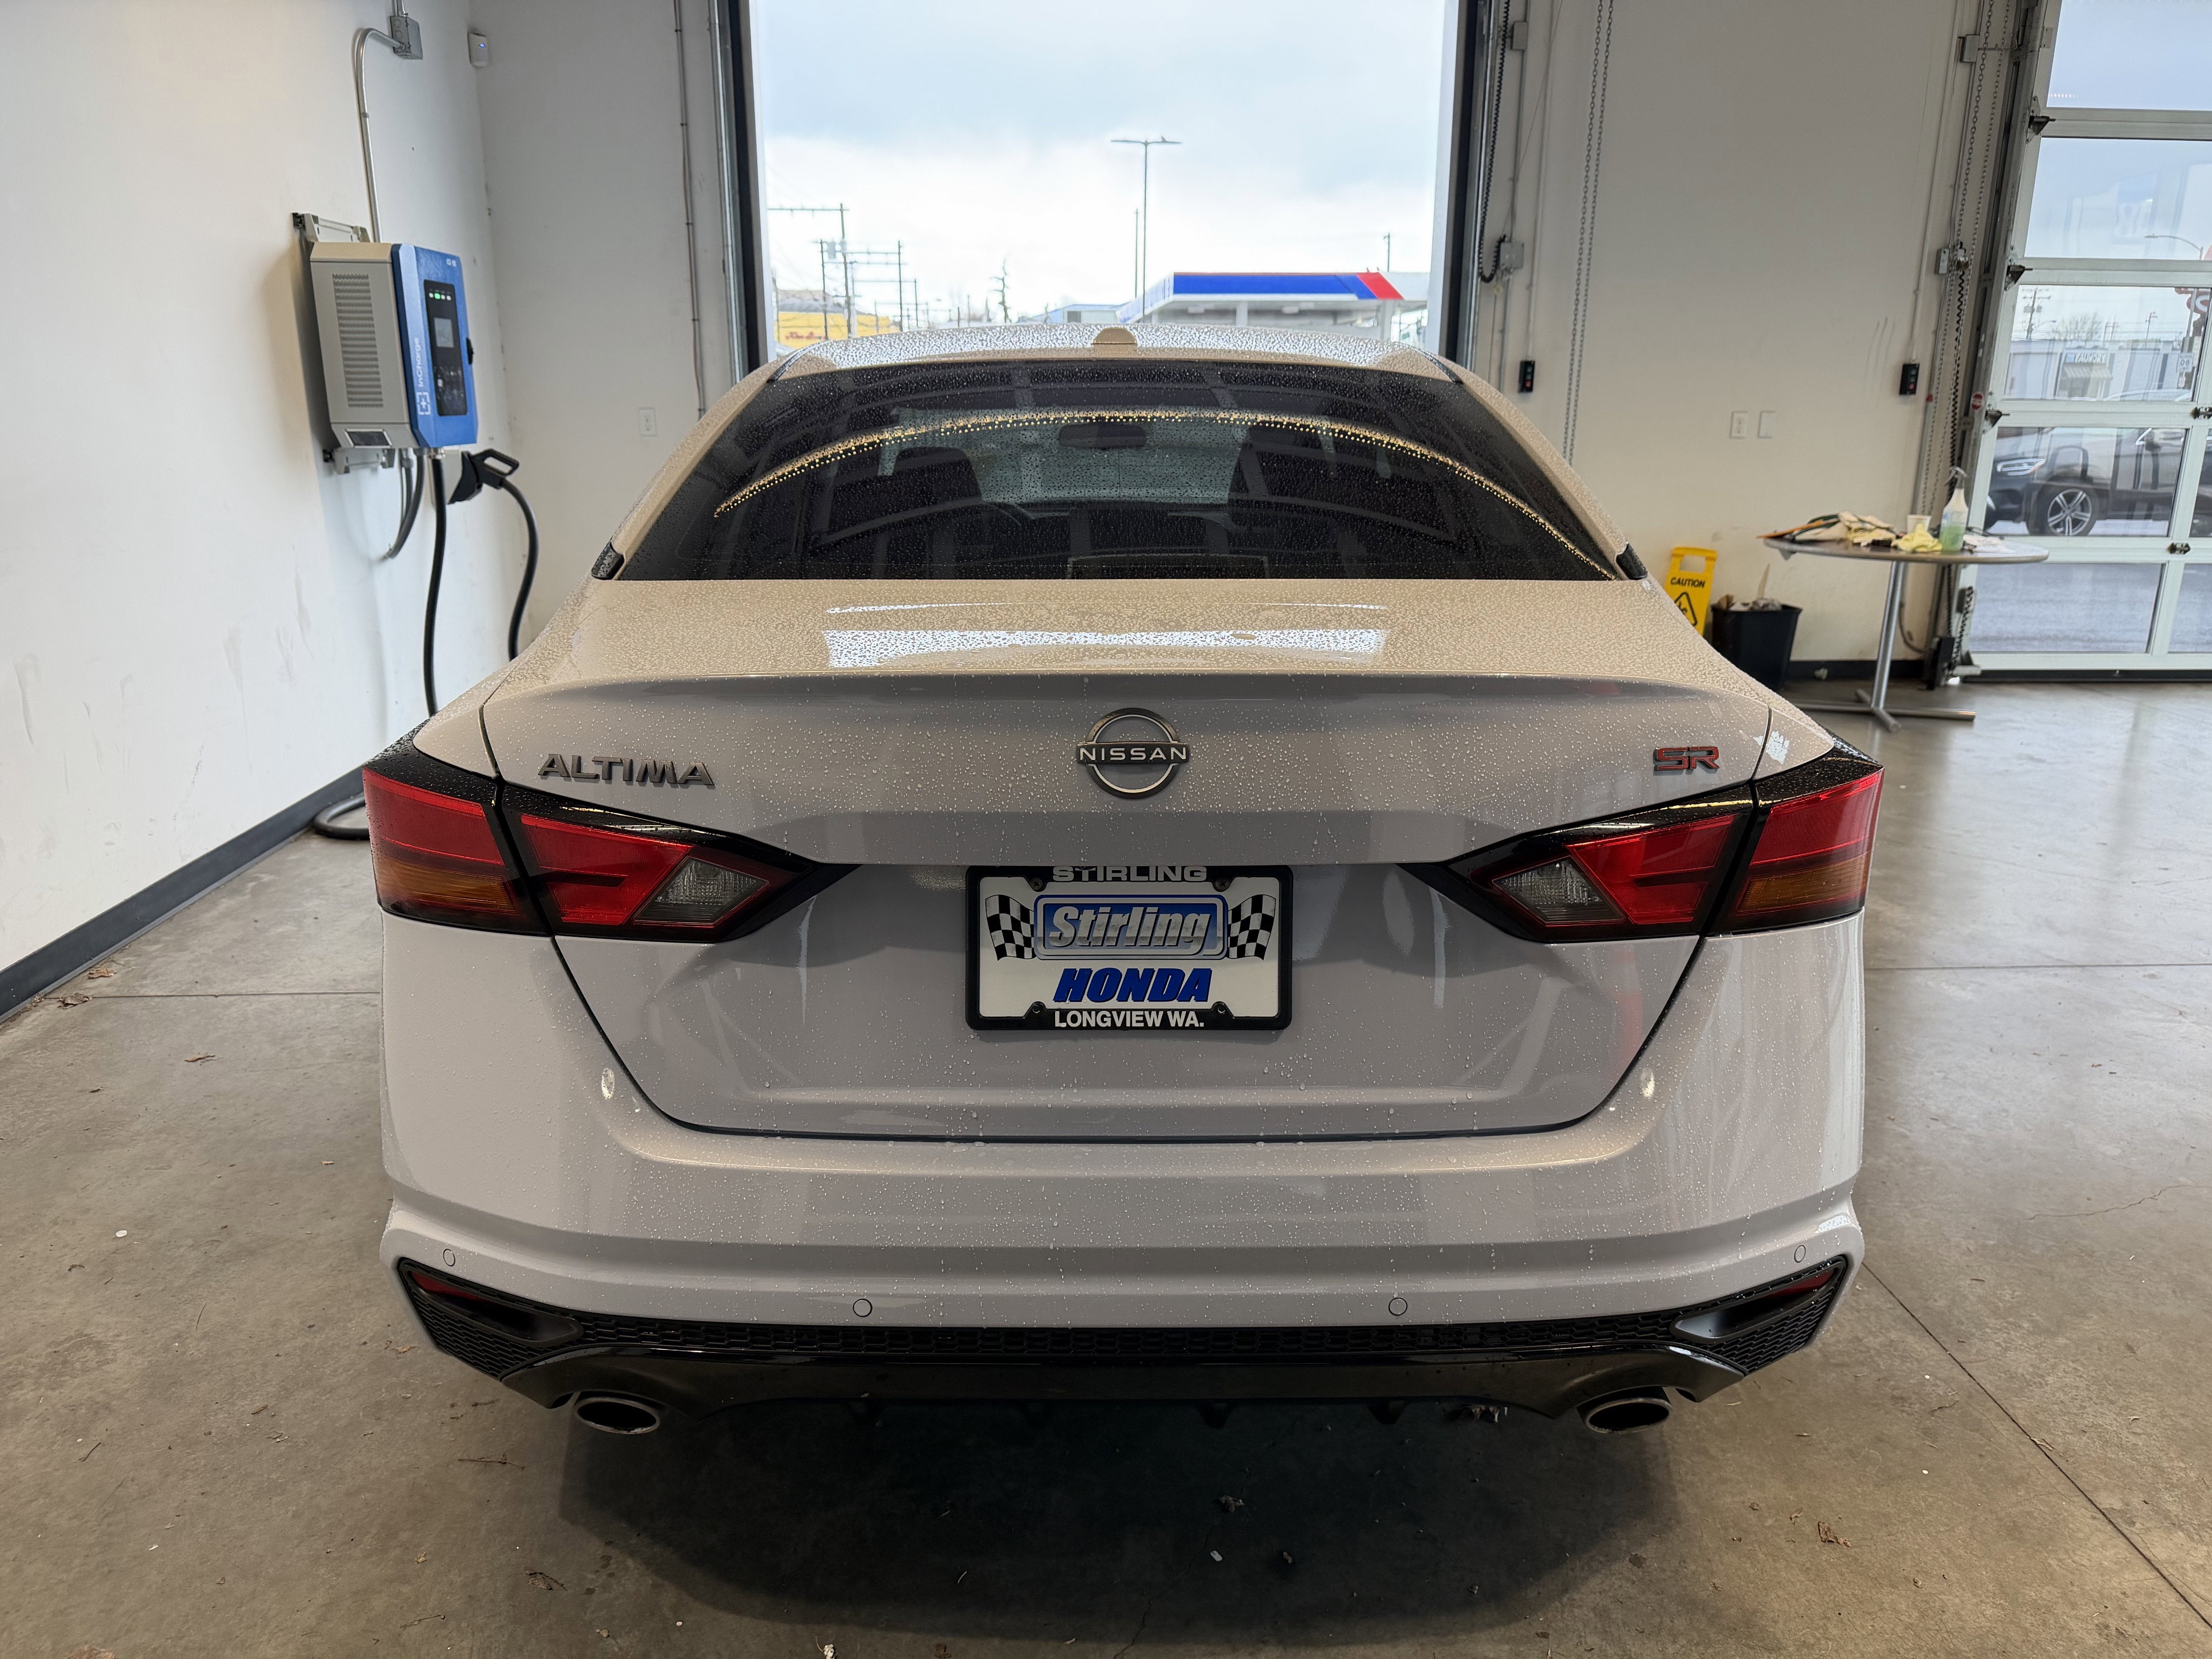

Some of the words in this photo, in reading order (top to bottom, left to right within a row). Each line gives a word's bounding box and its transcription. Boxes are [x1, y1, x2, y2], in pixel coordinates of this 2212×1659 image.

[1670, 577, 1705, 588] CAUTION
[1080, 747, 1187, 760] NISSAN
[1653, 746, 1720, 770] SR
[538, 753, 715, 786] ALTIMA
[1053, 866, 1207, 881] STIRLING
[1049, 906, 1211, 956] Stirling
[1053, 967, 1212, 1003] HONDA
[1055, 1010, 1163, 1027] LONGVIEW
[1167, 1010, 1204, 1027] WA.
